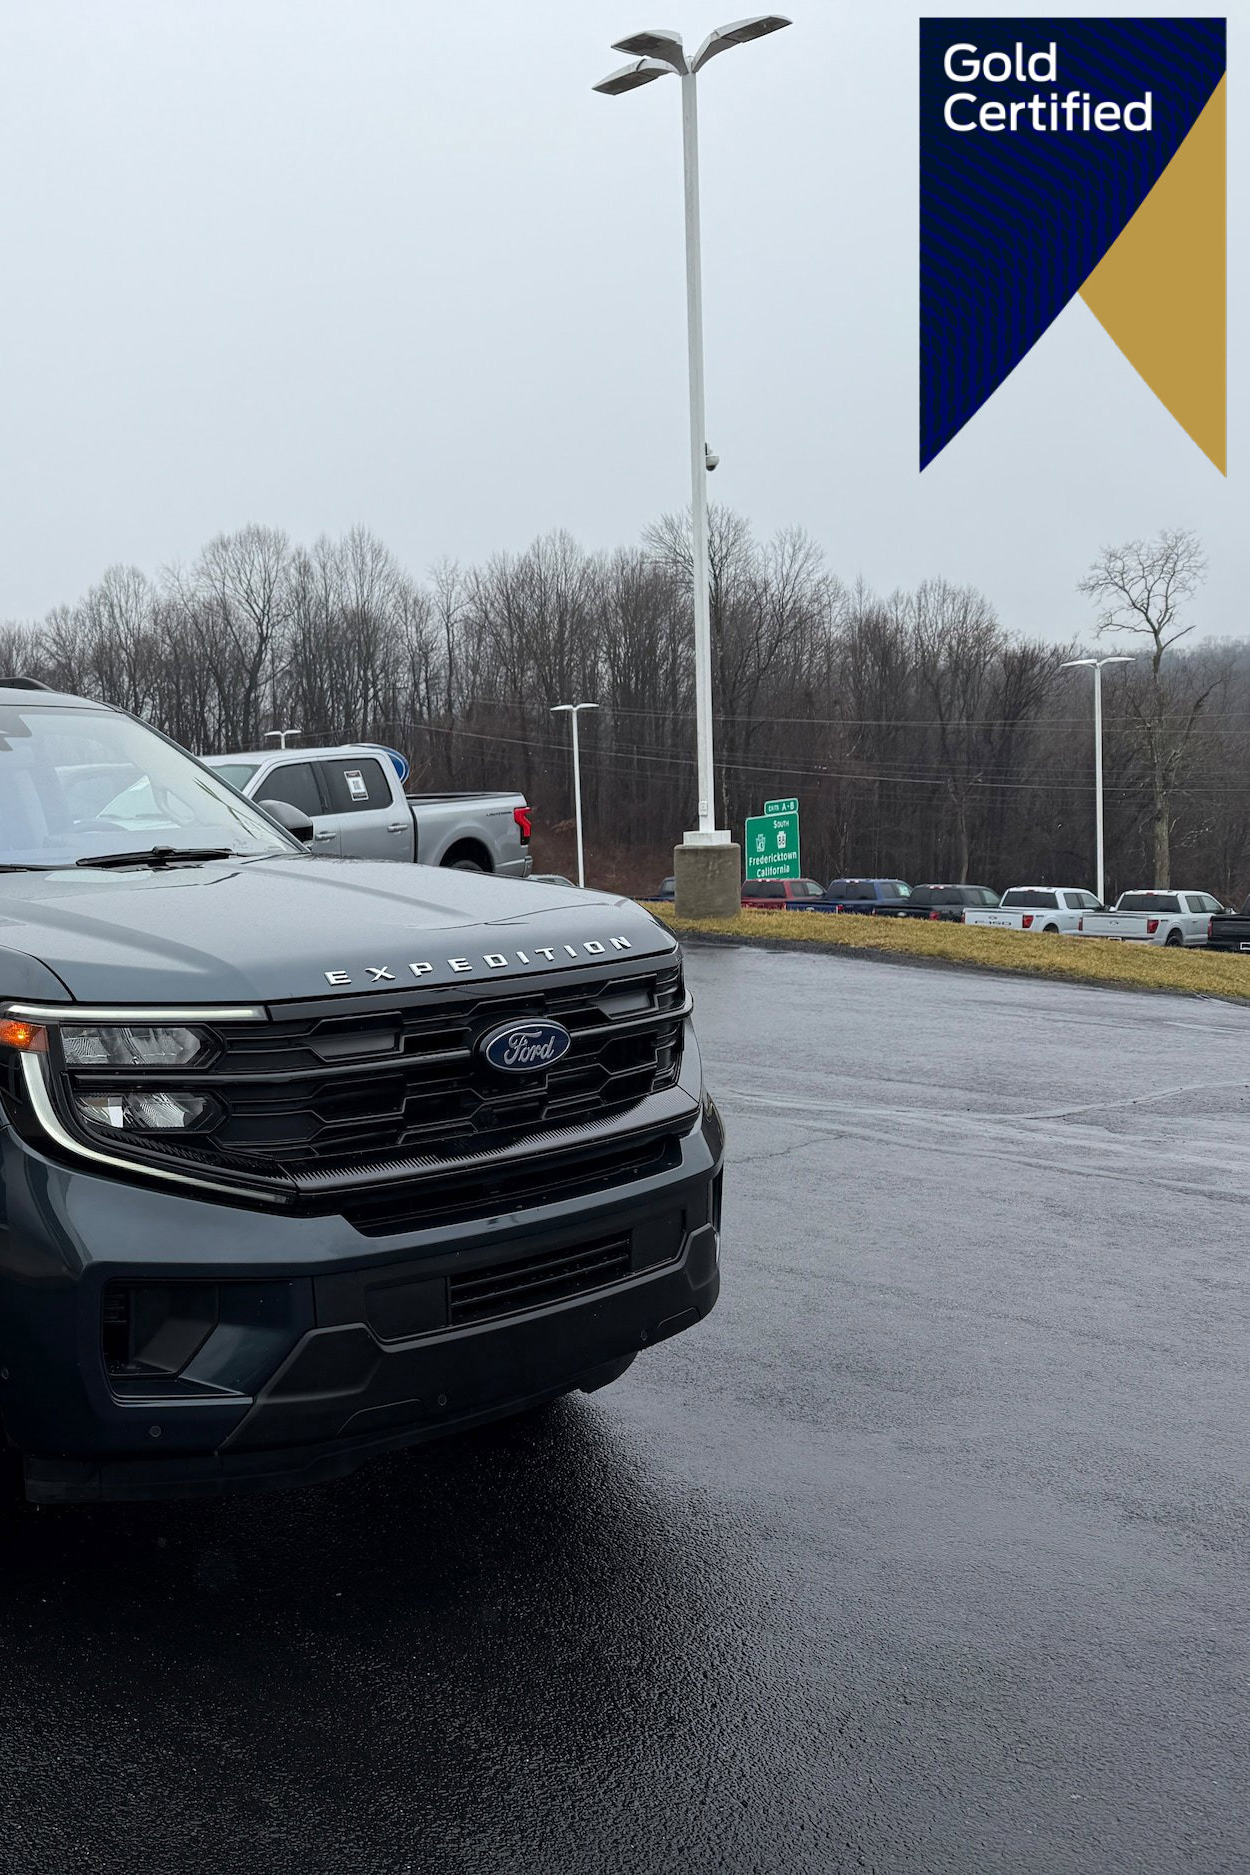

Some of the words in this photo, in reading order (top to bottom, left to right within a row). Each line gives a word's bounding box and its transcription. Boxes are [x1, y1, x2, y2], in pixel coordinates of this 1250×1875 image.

[773, 820, 789, 829] SOUTH
[749, 851, 797, 866] Fredericktown
[756, 864, 790, 878] California
[323, 936, 633, 986] EXPEDITION
[504, 1030, 556, 1065] Ford
